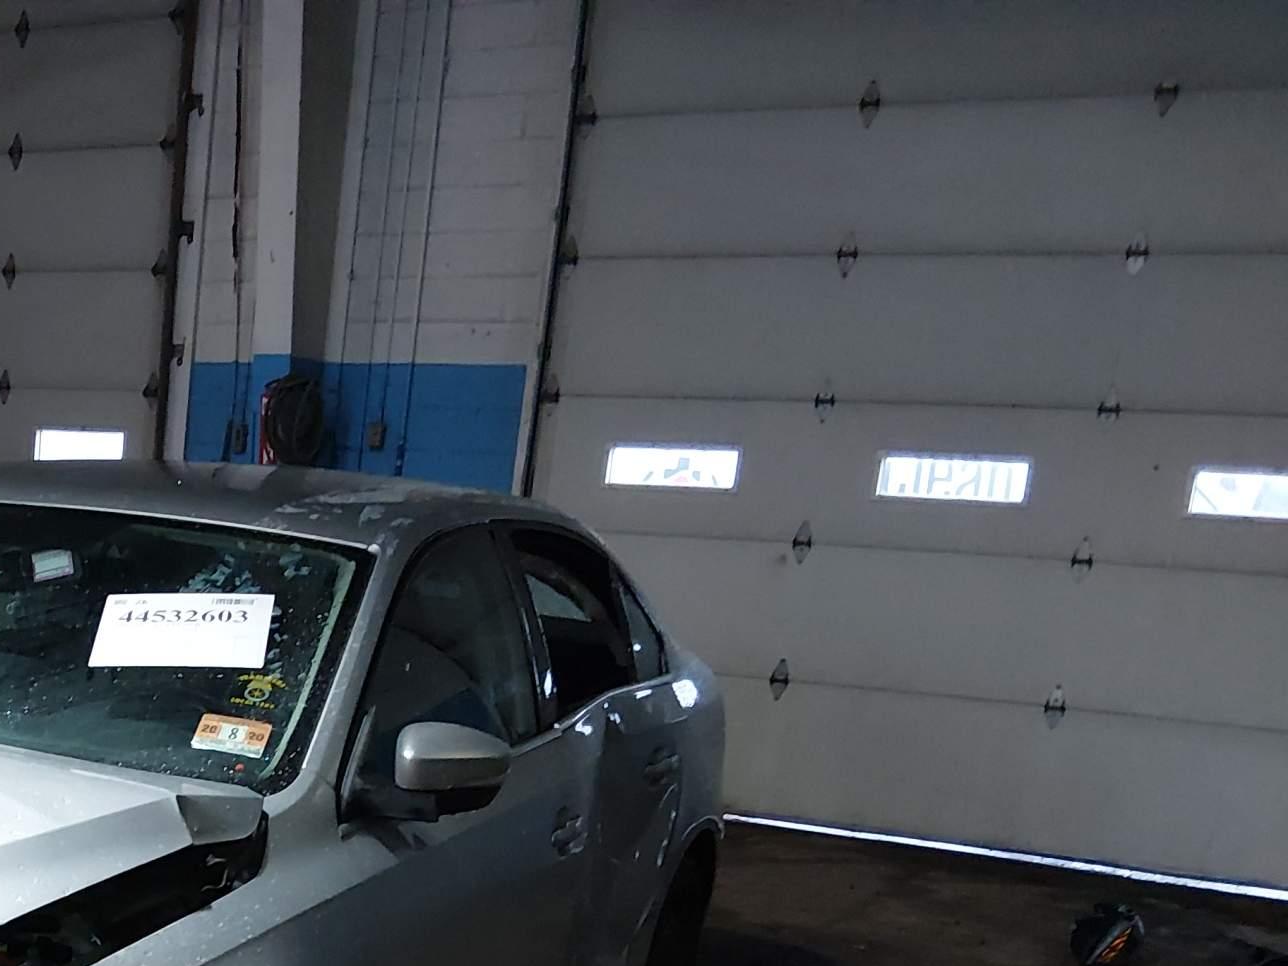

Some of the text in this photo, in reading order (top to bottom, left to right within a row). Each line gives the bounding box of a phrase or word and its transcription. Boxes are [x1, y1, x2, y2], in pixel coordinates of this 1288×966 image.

[118, 609, 249, 623] 44532603
[201, 724, 265, 742] 20 8 20
